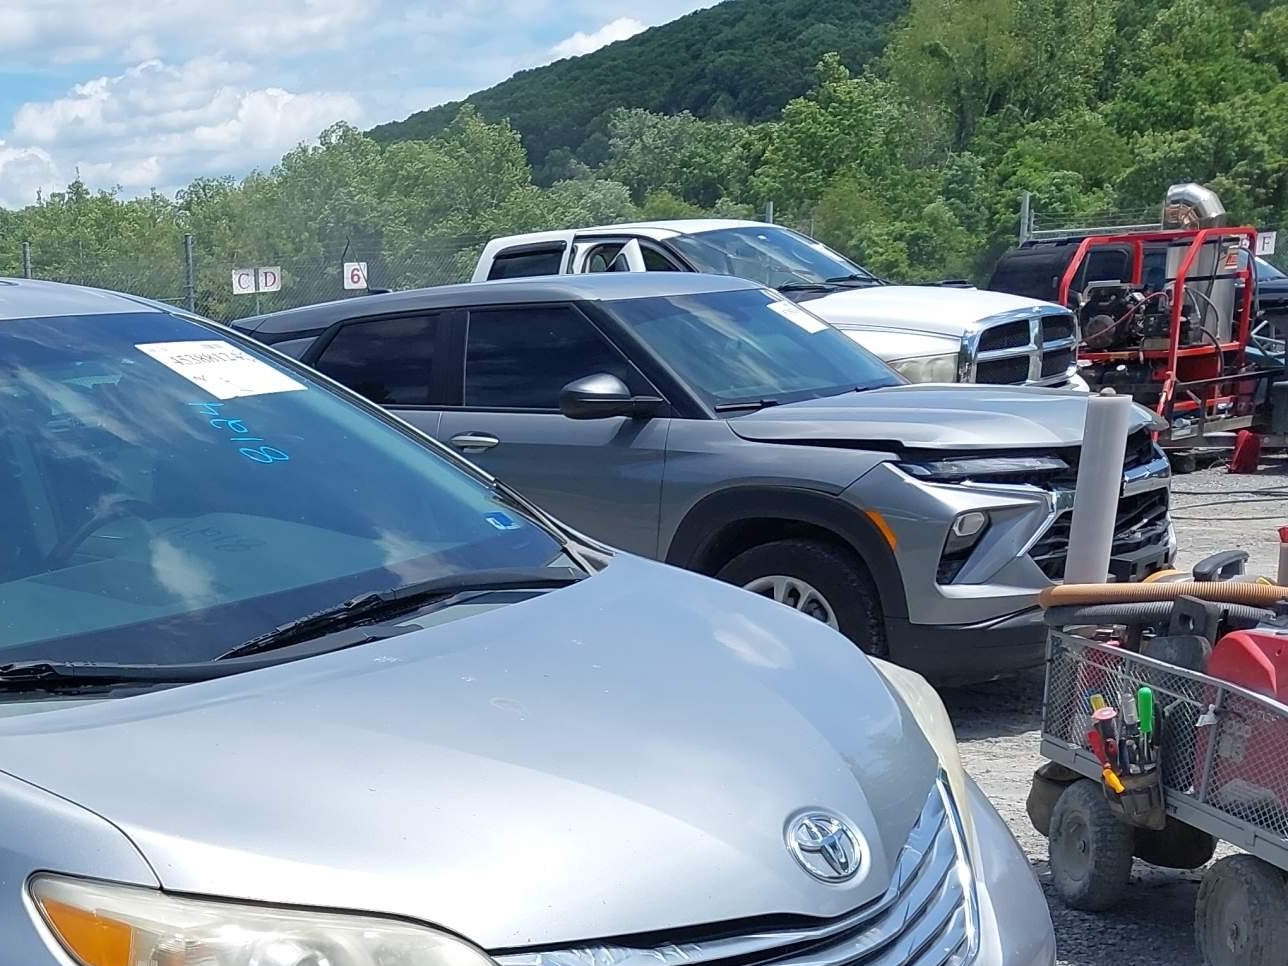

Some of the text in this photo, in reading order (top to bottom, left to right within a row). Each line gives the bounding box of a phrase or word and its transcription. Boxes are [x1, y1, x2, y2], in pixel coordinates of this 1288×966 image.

[1262, 236, 1272, 251] F
[237, 271, 277, 290] C D
[350, 267, 361, 284] 6
